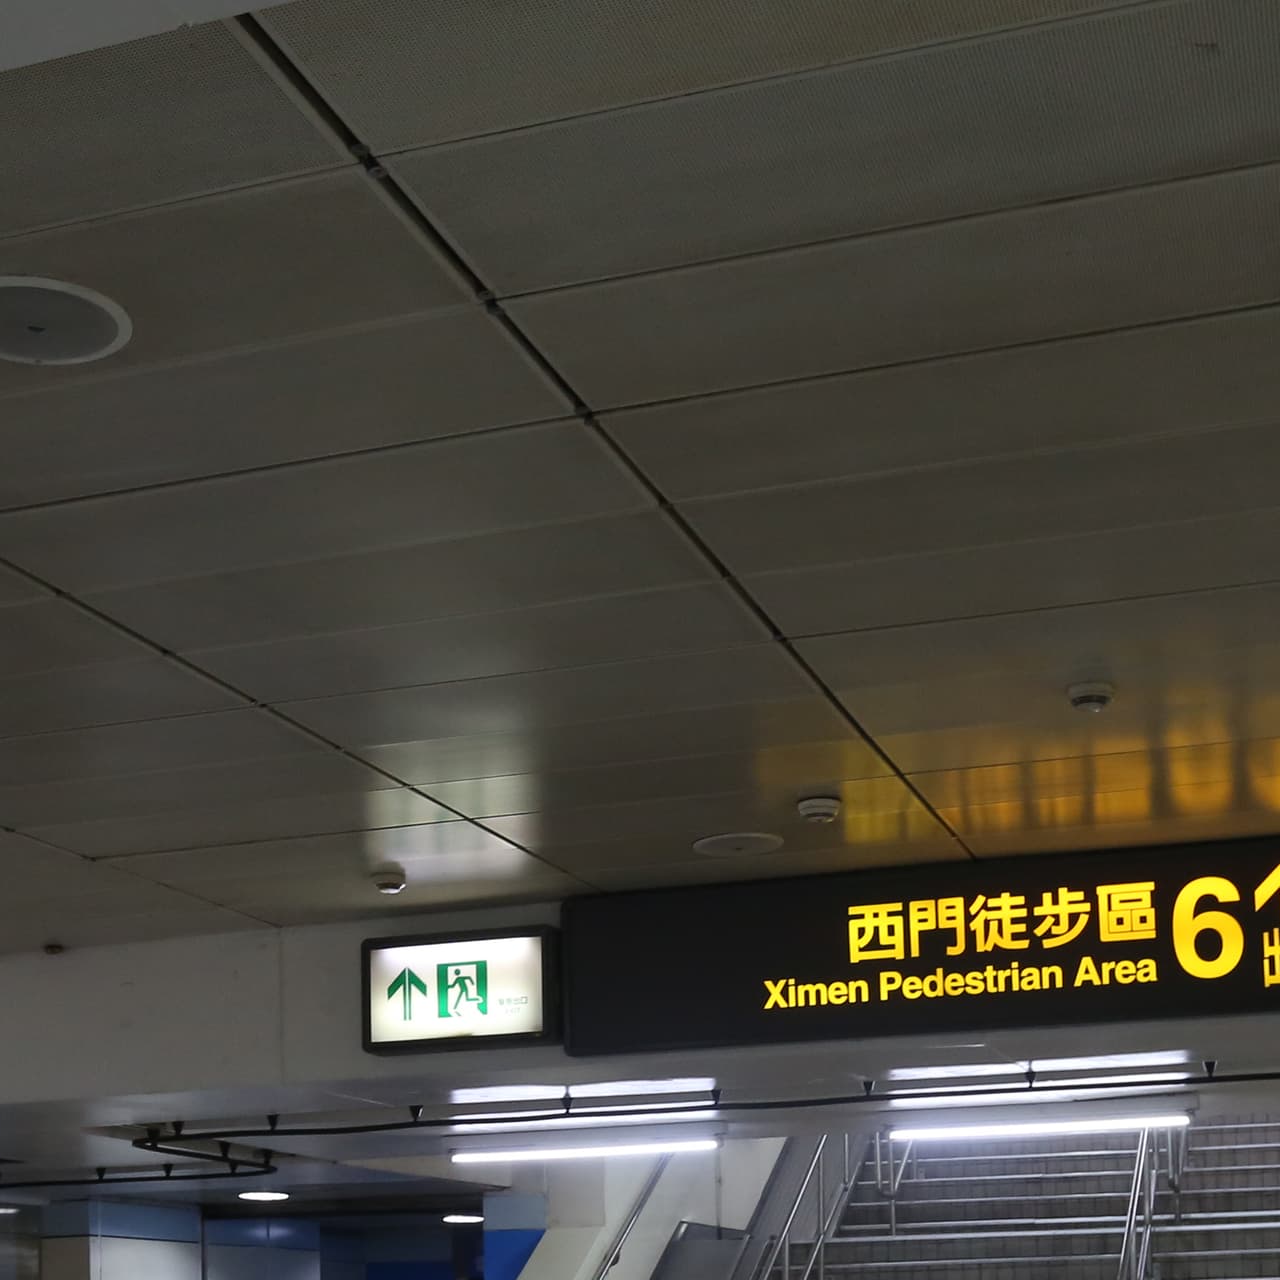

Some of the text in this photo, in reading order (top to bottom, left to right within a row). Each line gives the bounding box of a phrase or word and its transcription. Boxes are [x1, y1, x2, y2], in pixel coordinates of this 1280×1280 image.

[847, 880, 1157, 964] 西門徒步區
[1171, 876, 1245, 978] 6
[763, 955, 1157, 1010] Ximen Pedestrian Area
